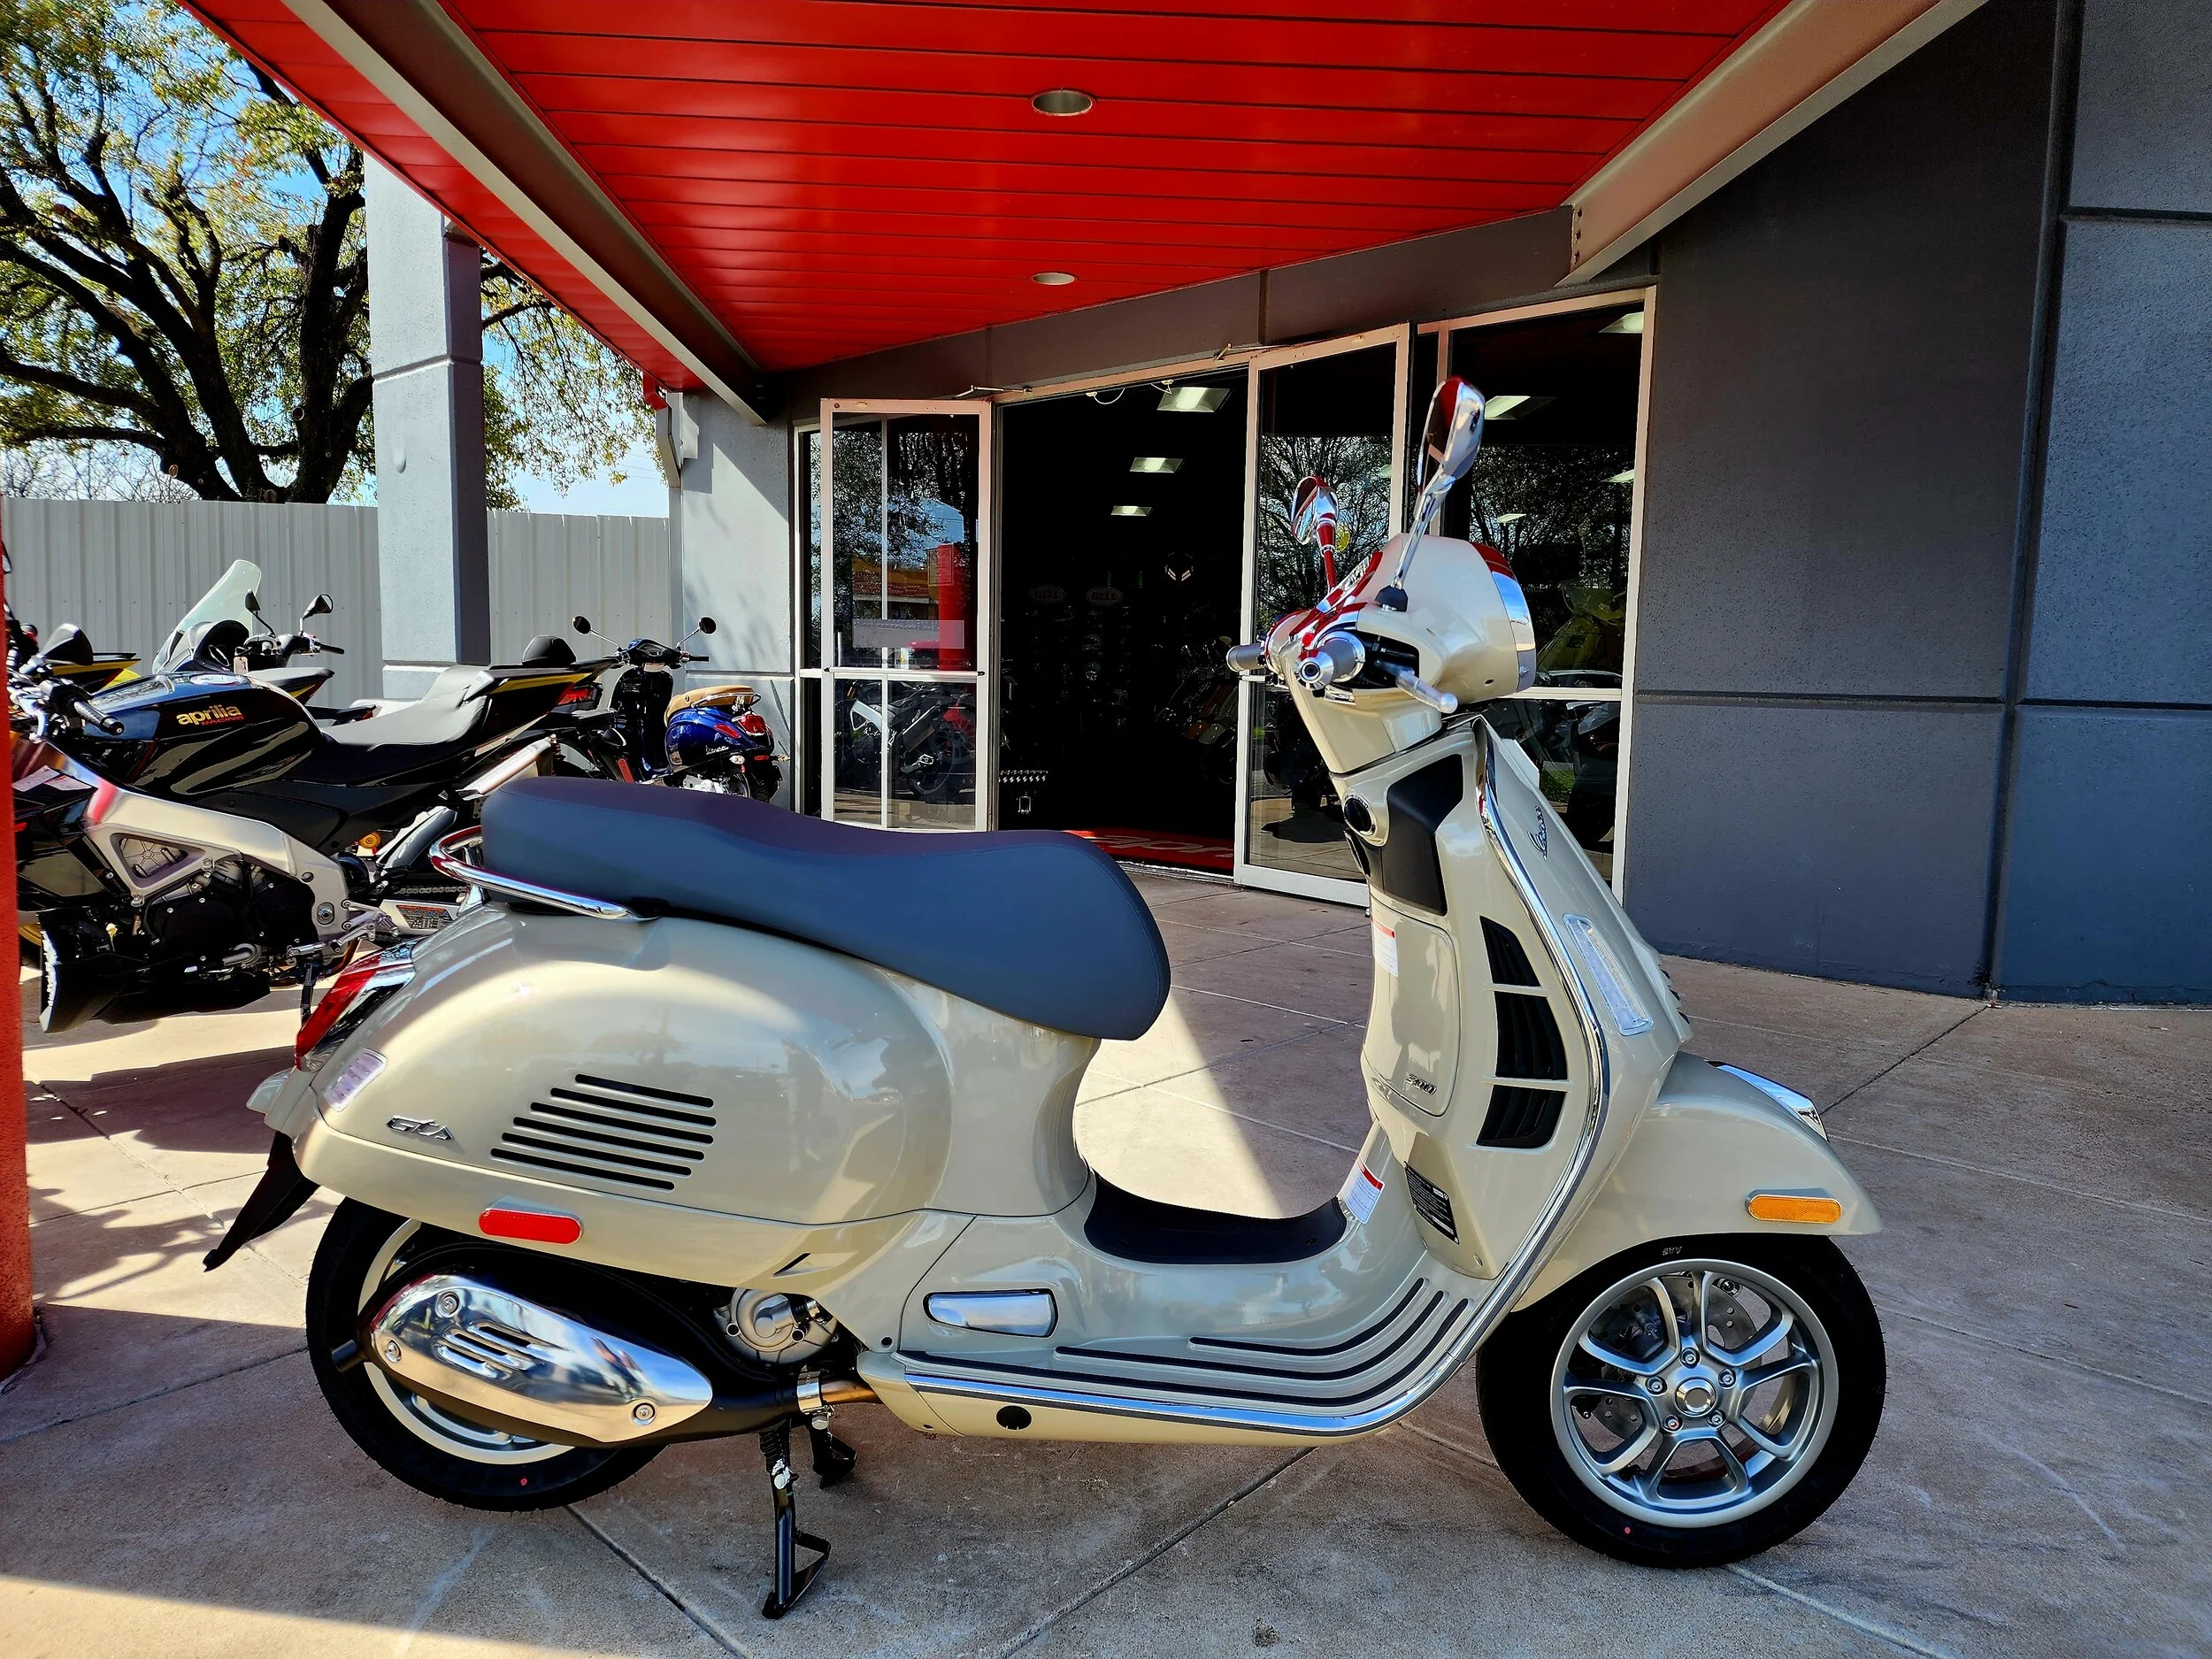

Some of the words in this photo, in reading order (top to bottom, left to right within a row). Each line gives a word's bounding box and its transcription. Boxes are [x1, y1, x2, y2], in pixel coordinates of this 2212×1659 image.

[176, 704, 242, 726] aprilia
[201, 715, 245, 726] RACING
[1405, 1072, 1438, 1095] 300
